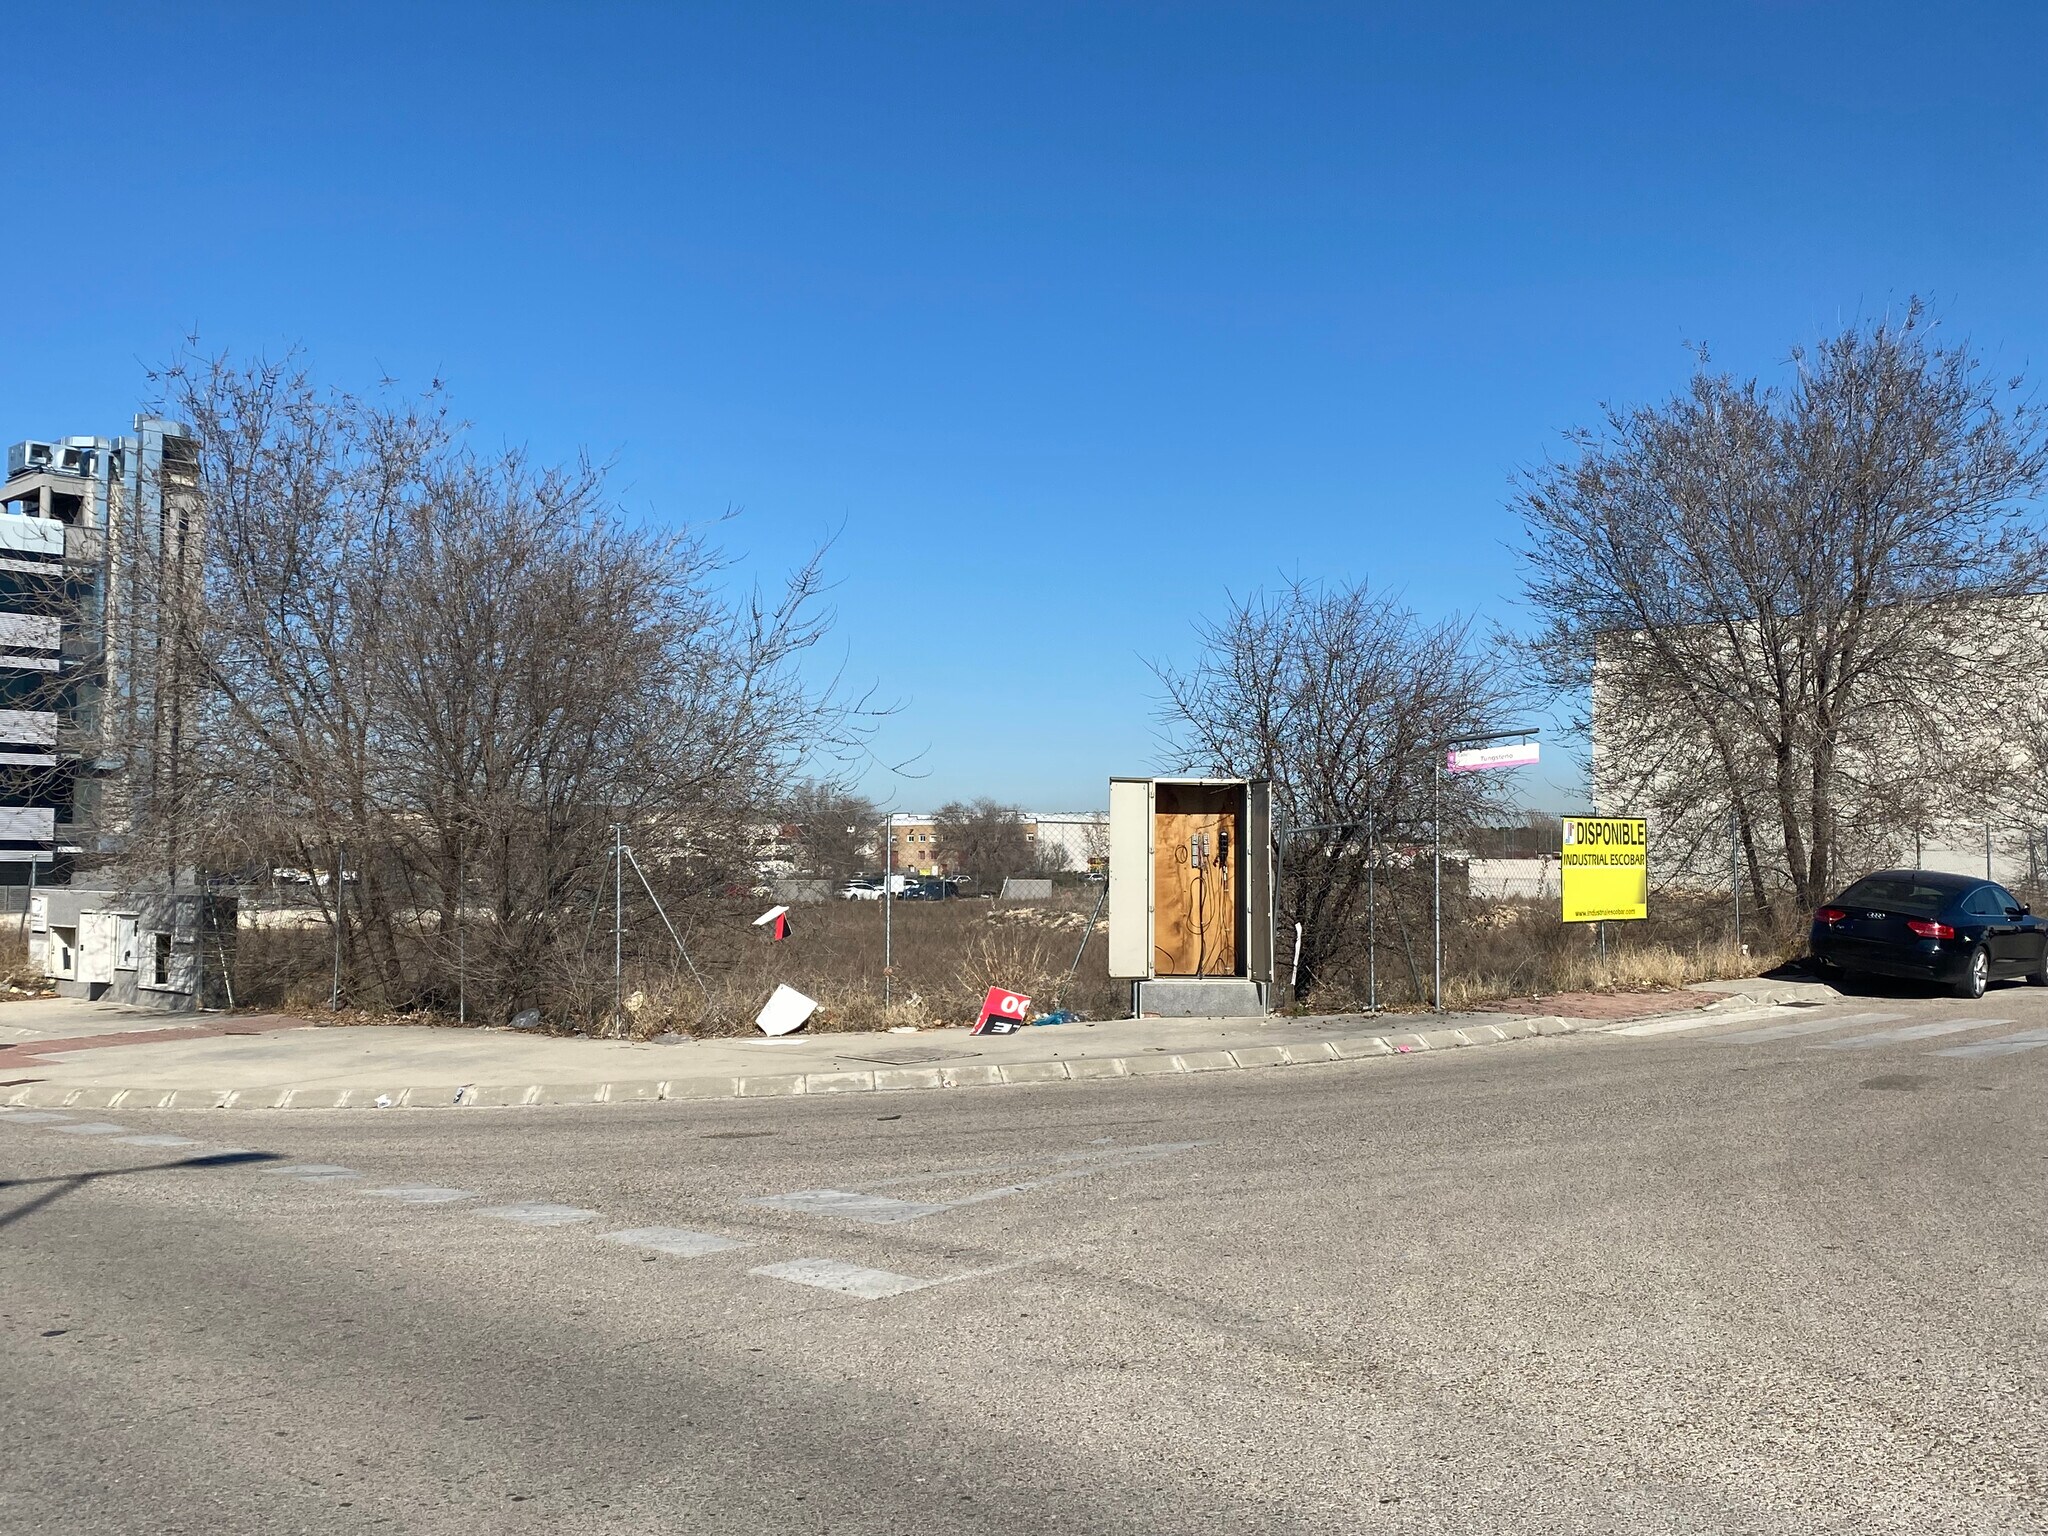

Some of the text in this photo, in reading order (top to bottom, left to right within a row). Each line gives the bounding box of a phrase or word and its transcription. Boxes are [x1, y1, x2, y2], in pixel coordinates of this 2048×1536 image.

[1480, 753, 1514, 762] Tungsteno
[1577, 822, 1645, 845] DISPONIBLE
[1563, 853, 1645, 866] INDUSTRIAL ESCOBAR
[1575, 908, 1636, 917] www.industrialescobar.com
